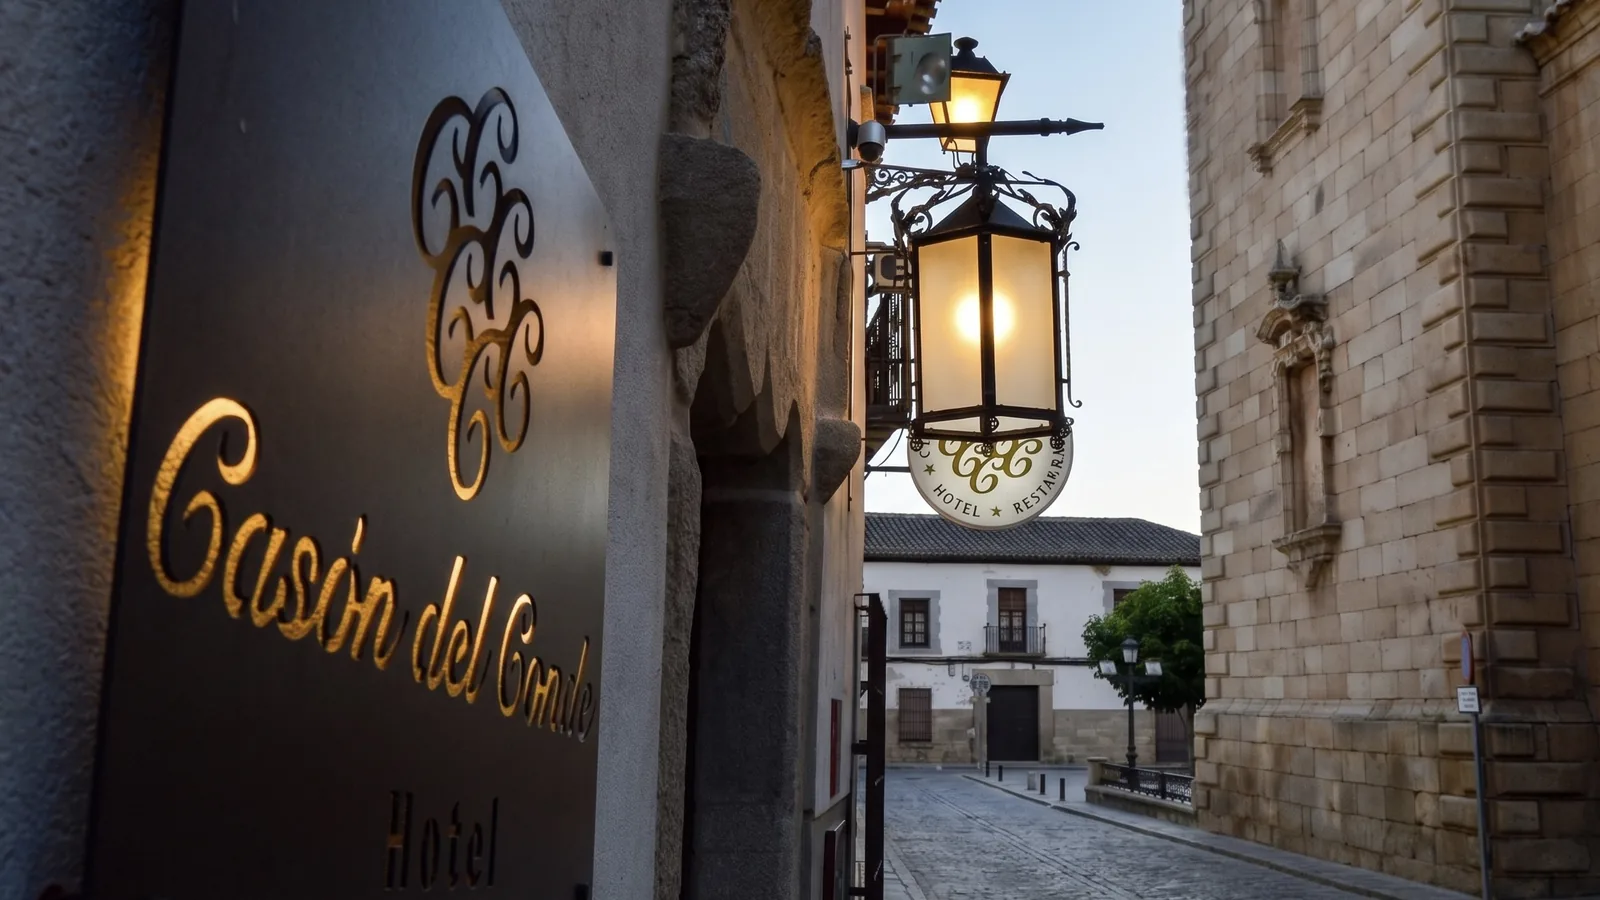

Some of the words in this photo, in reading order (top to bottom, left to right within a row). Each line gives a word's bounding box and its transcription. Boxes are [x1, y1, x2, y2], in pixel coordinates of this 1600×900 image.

[933, 484, 980, 517] HOTEL
[412, 555, 498, 704] del
[497, 592, 597, 743] Conde
[383, 790, 498, 891] Hotel
